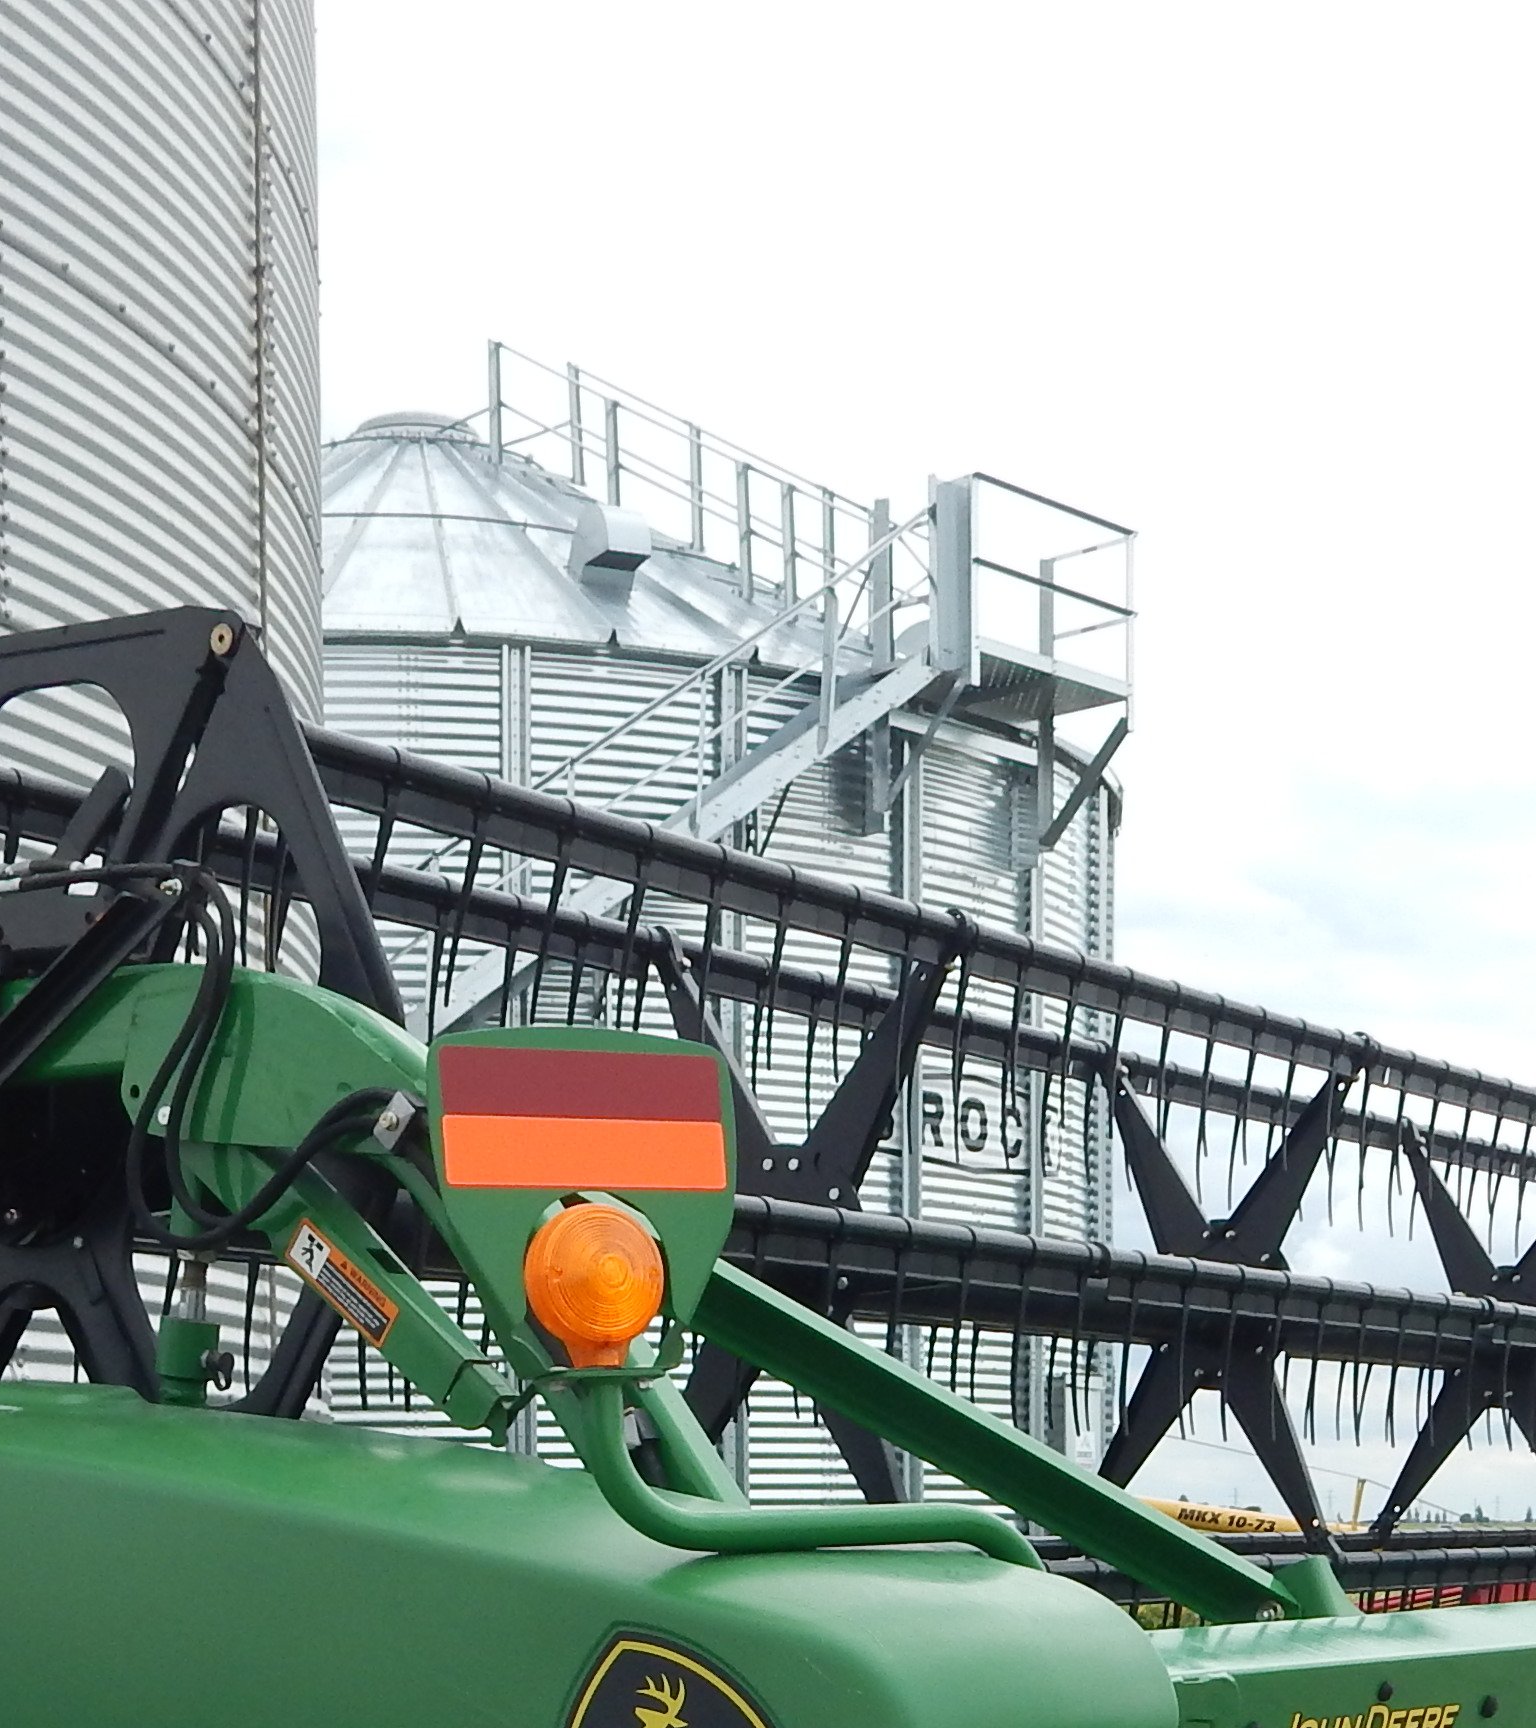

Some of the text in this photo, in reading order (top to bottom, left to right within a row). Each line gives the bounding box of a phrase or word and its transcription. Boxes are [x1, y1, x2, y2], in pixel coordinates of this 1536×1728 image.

[350, 1267, 386, 1307] WARNING
[1178, 1508, 1276, 1533] MKX 10-73
